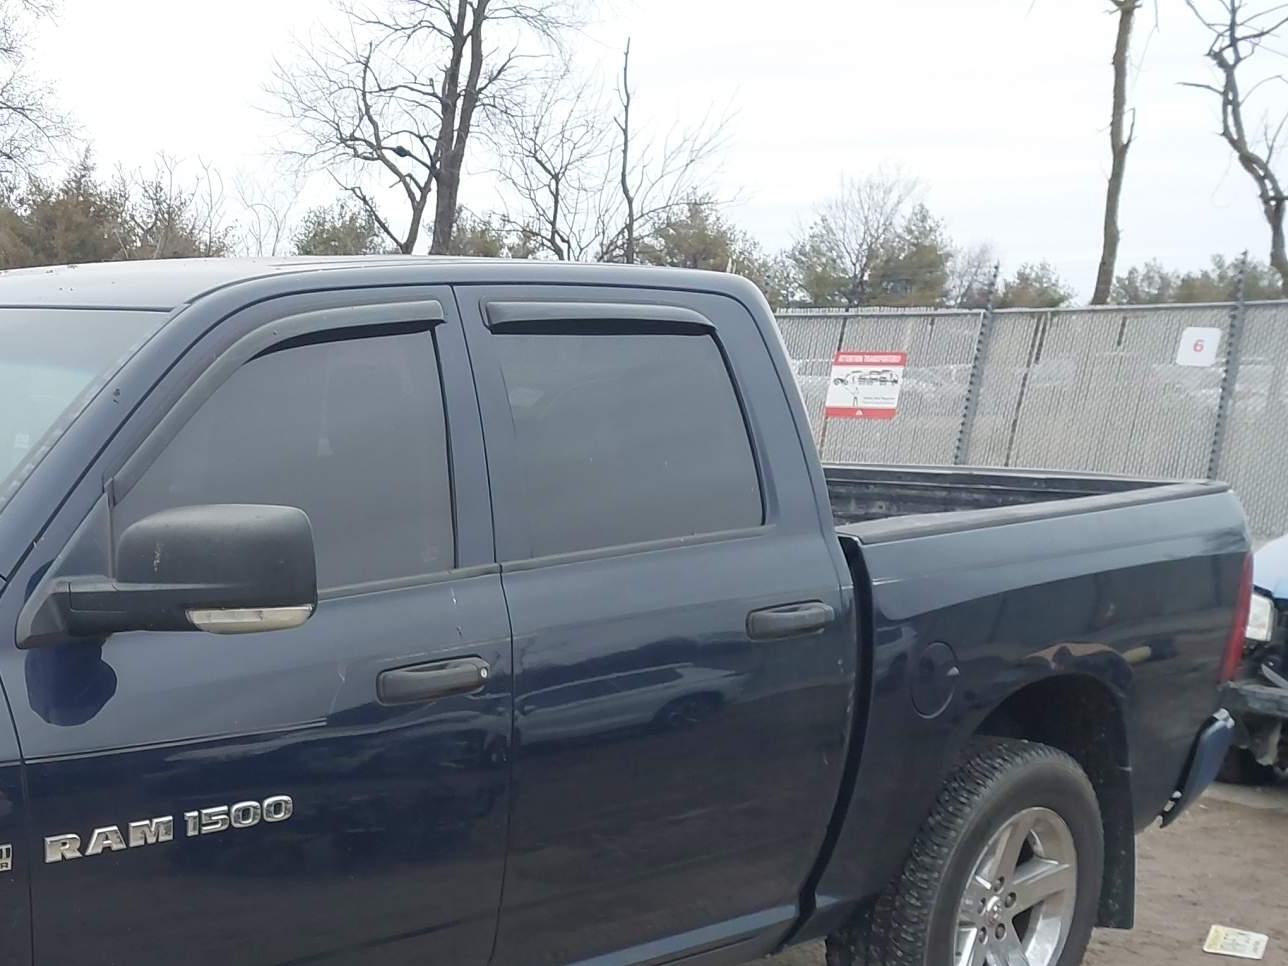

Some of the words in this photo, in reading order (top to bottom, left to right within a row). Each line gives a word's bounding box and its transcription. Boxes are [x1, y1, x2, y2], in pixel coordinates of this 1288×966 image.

[1192, 338, 1205, 353] 6
[44, 814, 174, 864] RAM
[184, 795, 294, 838] 1500
